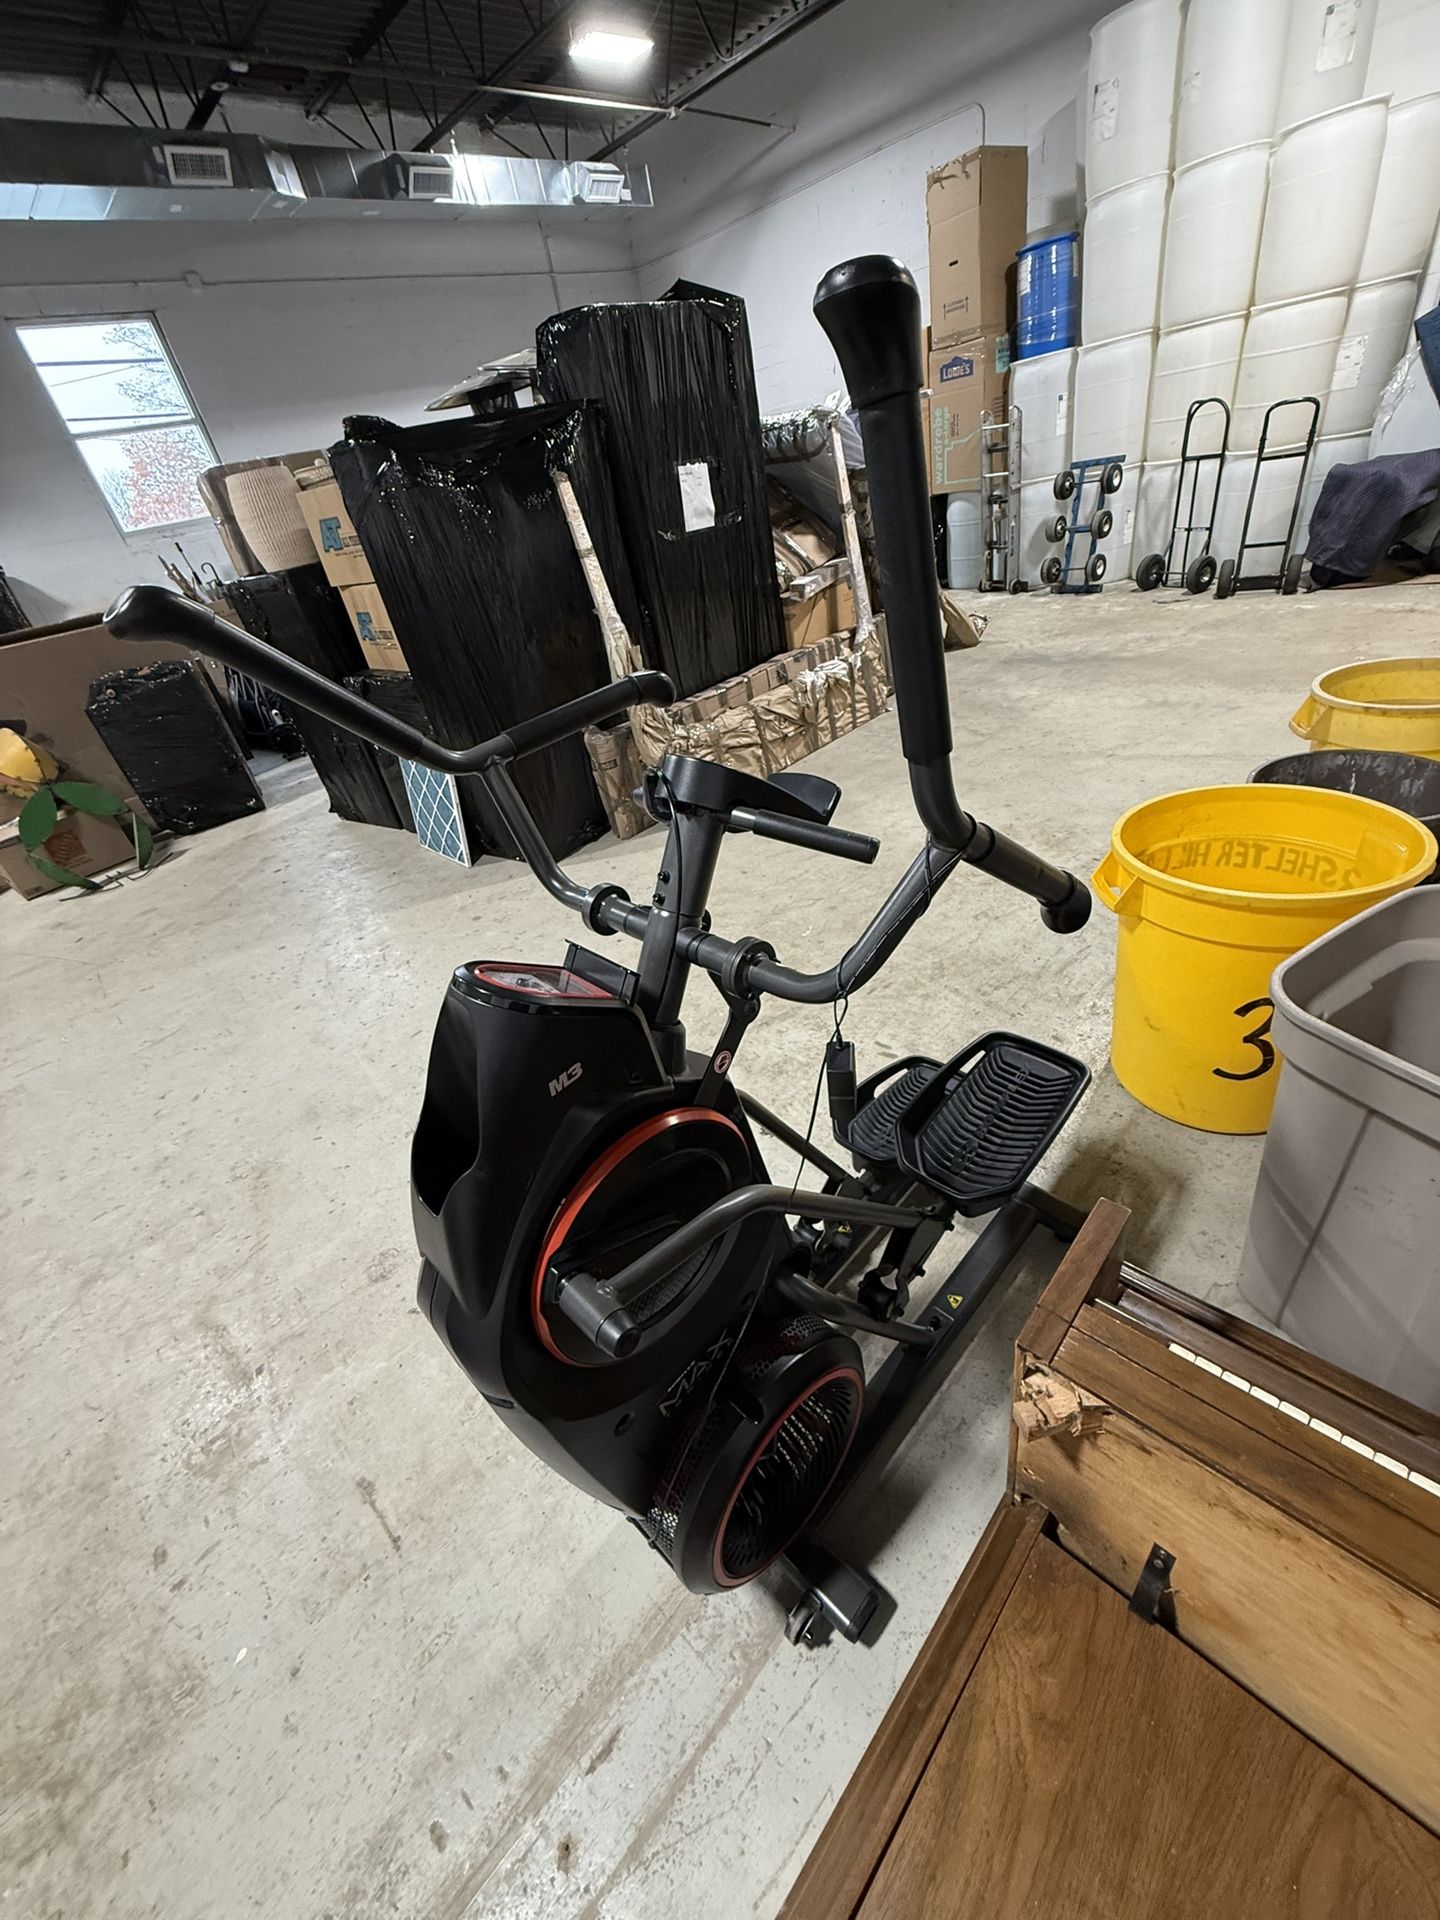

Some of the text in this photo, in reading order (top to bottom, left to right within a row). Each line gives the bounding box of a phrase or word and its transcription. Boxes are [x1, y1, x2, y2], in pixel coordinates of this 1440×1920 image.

[943, 363, 971, 379] LOWE'S
[1212, 997, 1275, 1080] 3
[548, 1062, 583, 1097] M3
[659, 1328, 733, 1416] MAX
